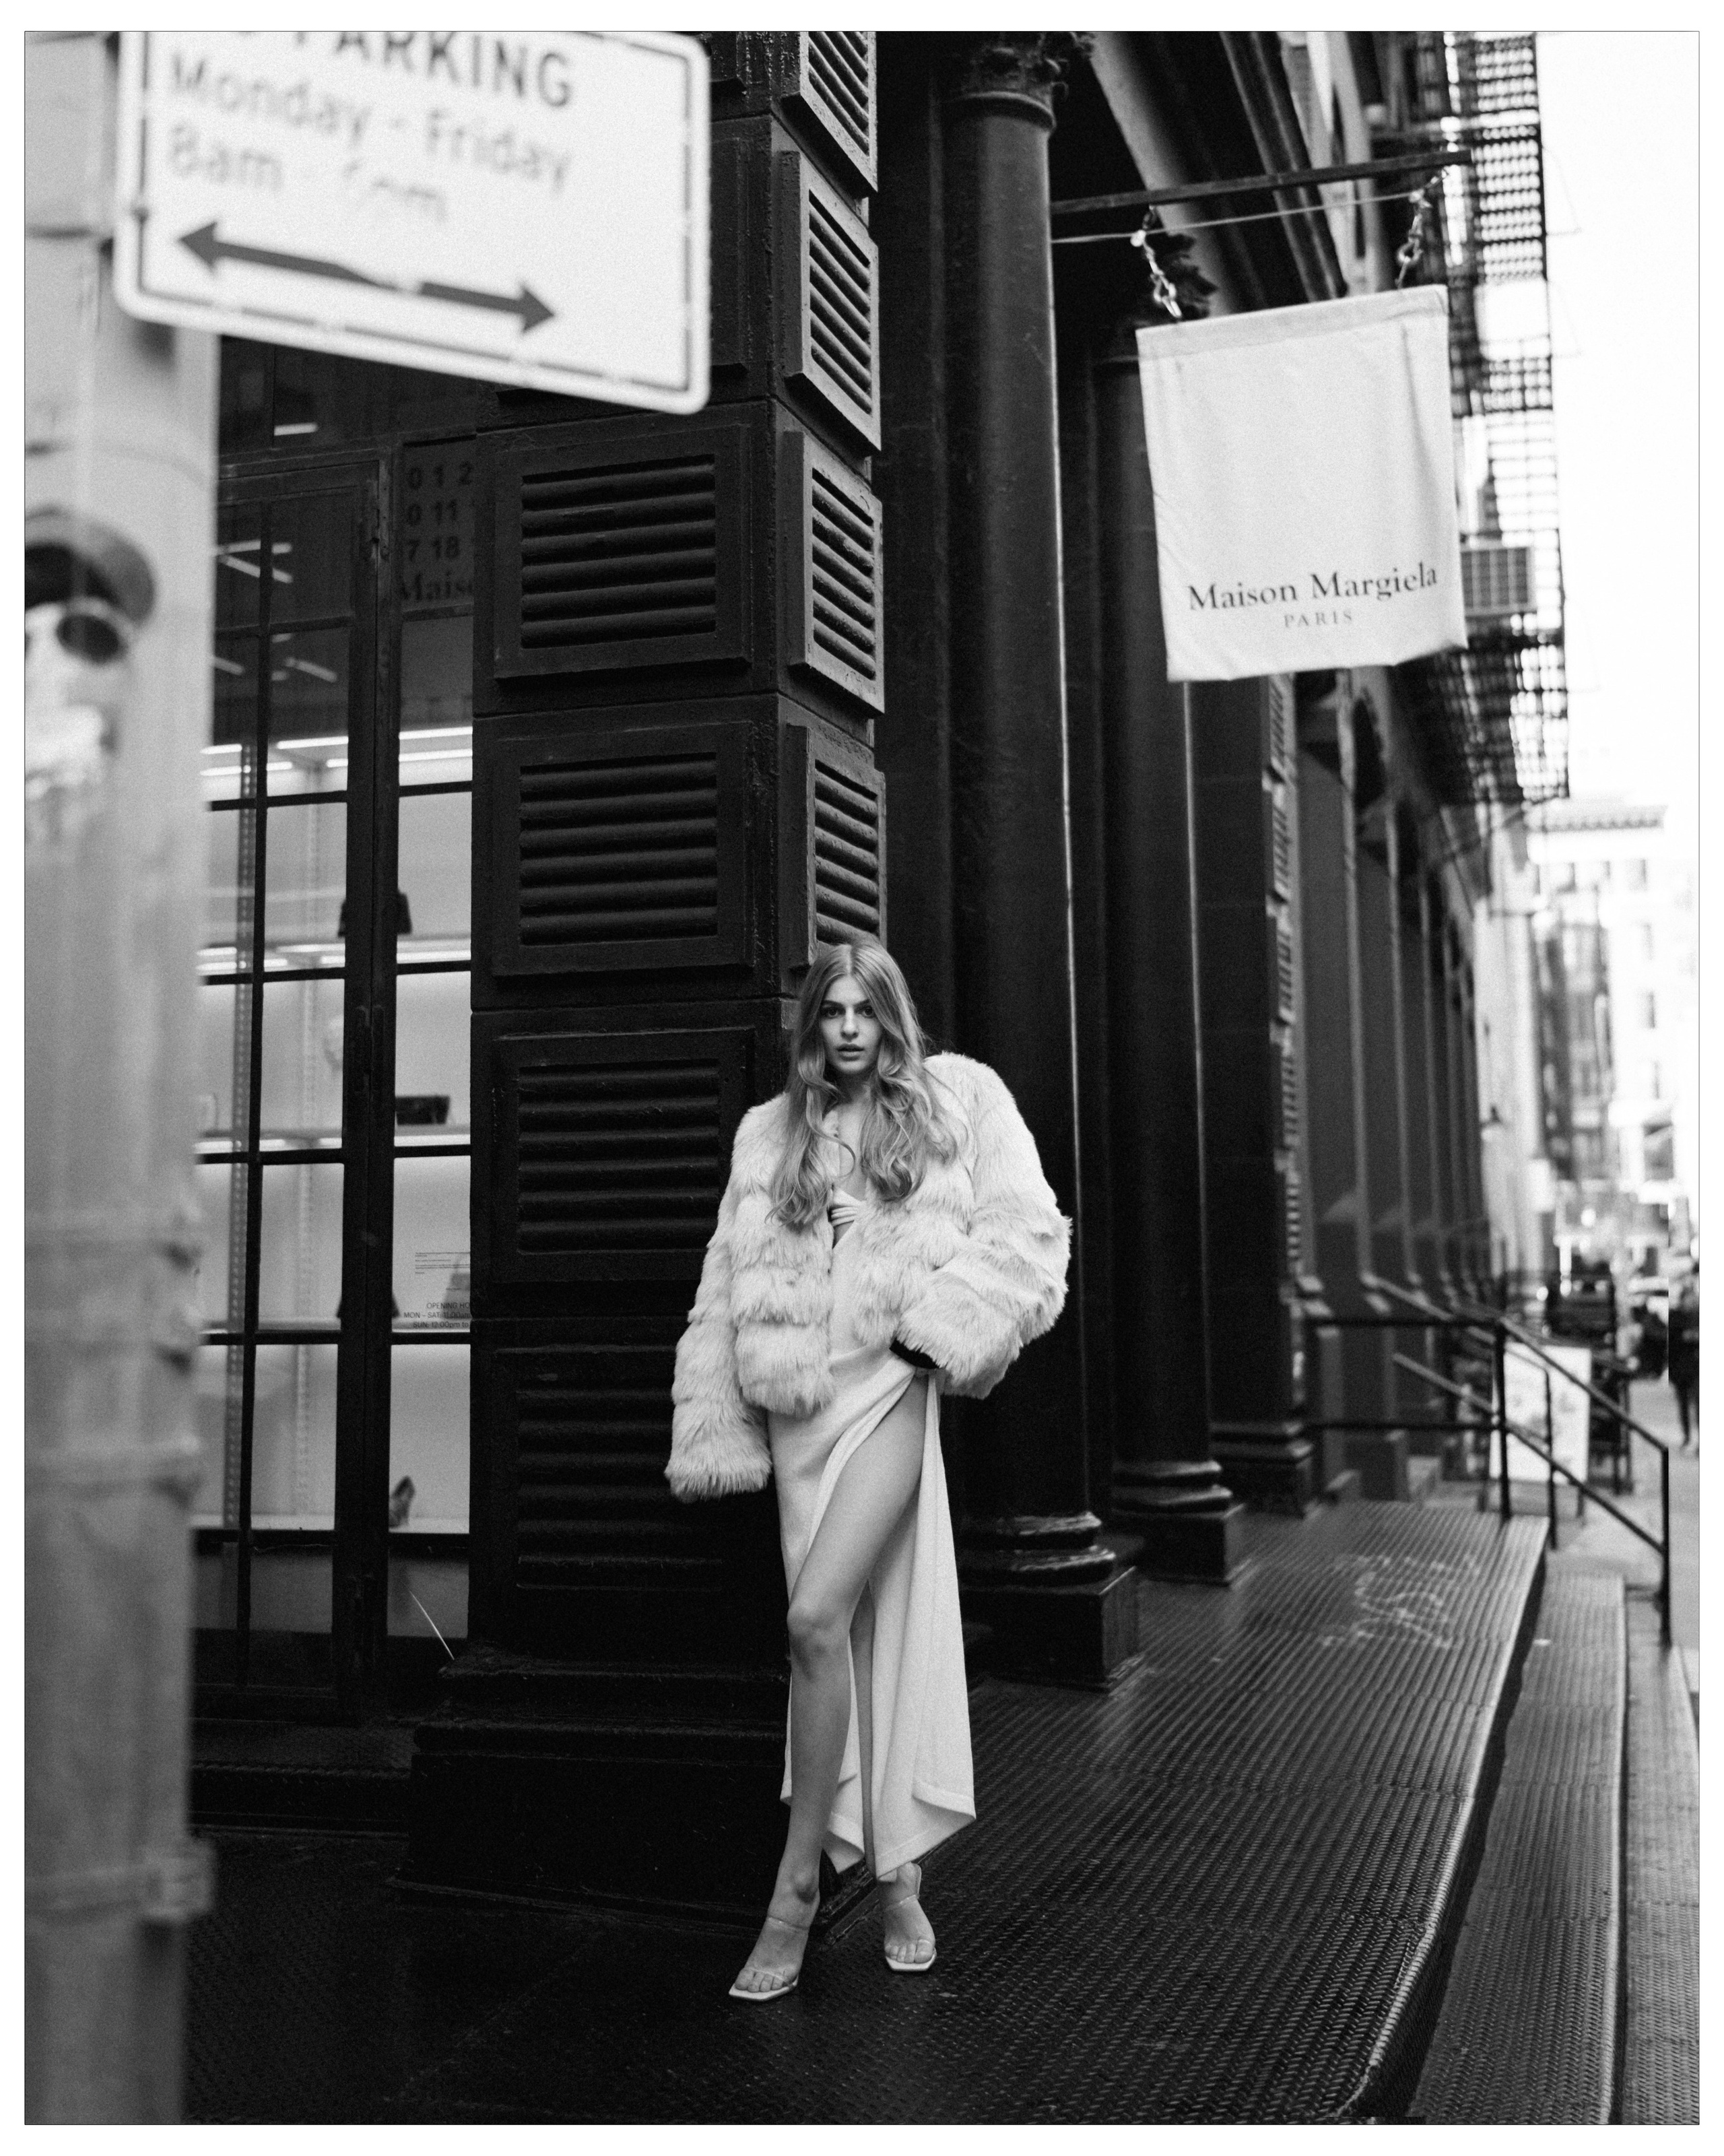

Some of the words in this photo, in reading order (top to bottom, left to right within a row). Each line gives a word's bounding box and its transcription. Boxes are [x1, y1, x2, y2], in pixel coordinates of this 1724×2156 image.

[1188, 582, 1298, 610] Maison
[1311, 561, 1438, 601] Margiela
[1284, 610, 1352, 628] PARIS
